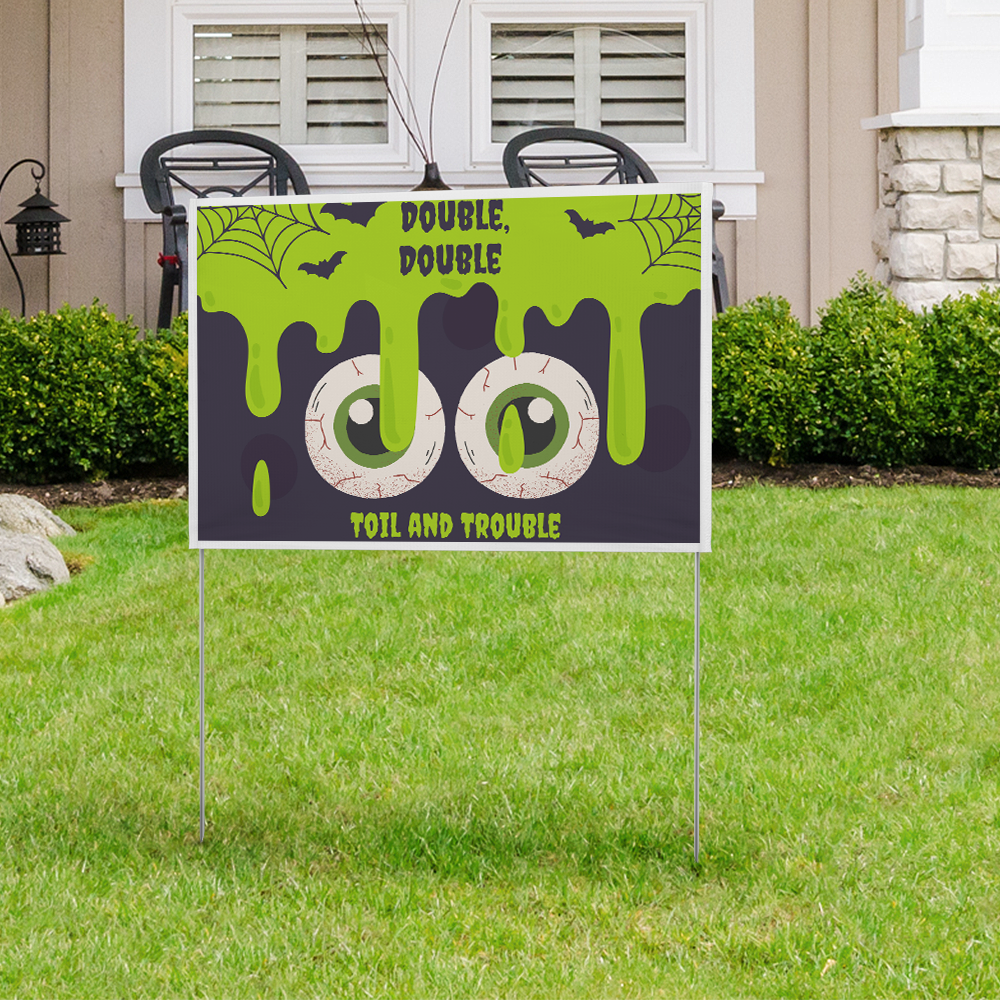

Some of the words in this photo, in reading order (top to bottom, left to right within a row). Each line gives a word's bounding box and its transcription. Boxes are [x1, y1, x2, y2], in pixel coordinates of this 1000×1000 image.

[401, 200, 509, 234] DOUBLE,
[399, 243, 501, 277] DOUBLE
[350, 512, 401, 539] TOIL
[408, 512, 453, 538] AND
[461, 513, 560, 539] TROUBLE
